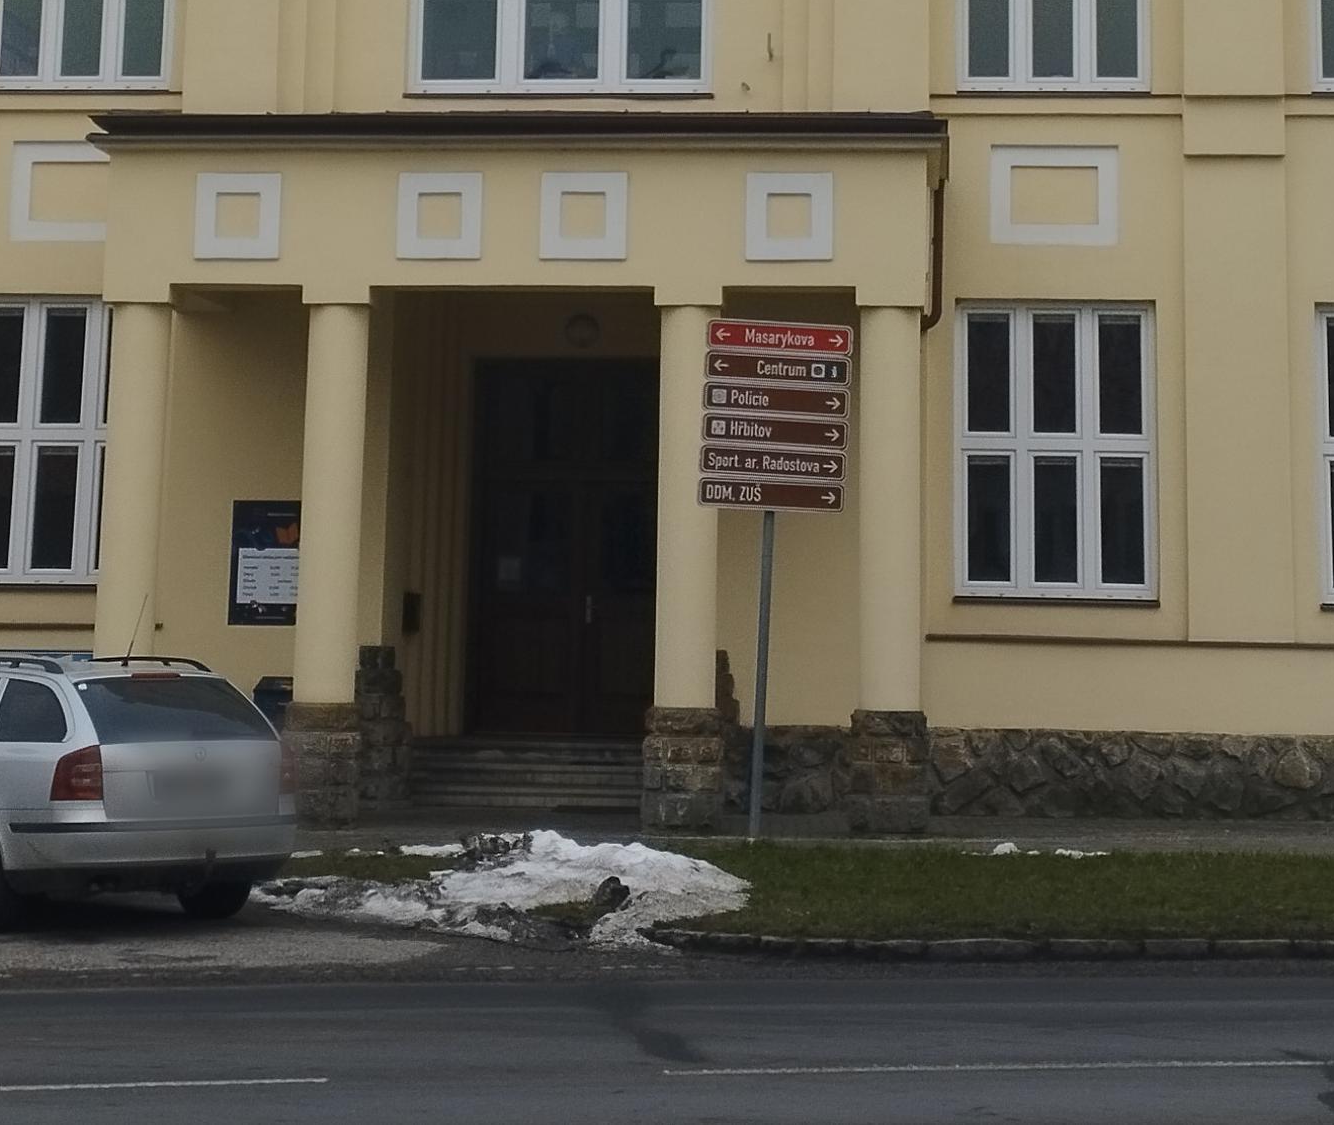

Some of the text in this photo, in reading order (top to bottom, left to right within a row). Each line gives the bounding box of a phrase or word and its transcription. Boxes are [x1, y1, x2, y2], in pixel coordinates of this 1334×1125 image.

[744, 328, 815, 348] Masarykova
[756, 360, 806, 377] Centrum
[730, 389, 769, 406] Policie
[730, 419, 772, 438] Hřbitov
[744, 457, 759, 470] ar.
[762, 455, 820, 473] Radostova
[739, 483, 762, 502] ZUŠ
